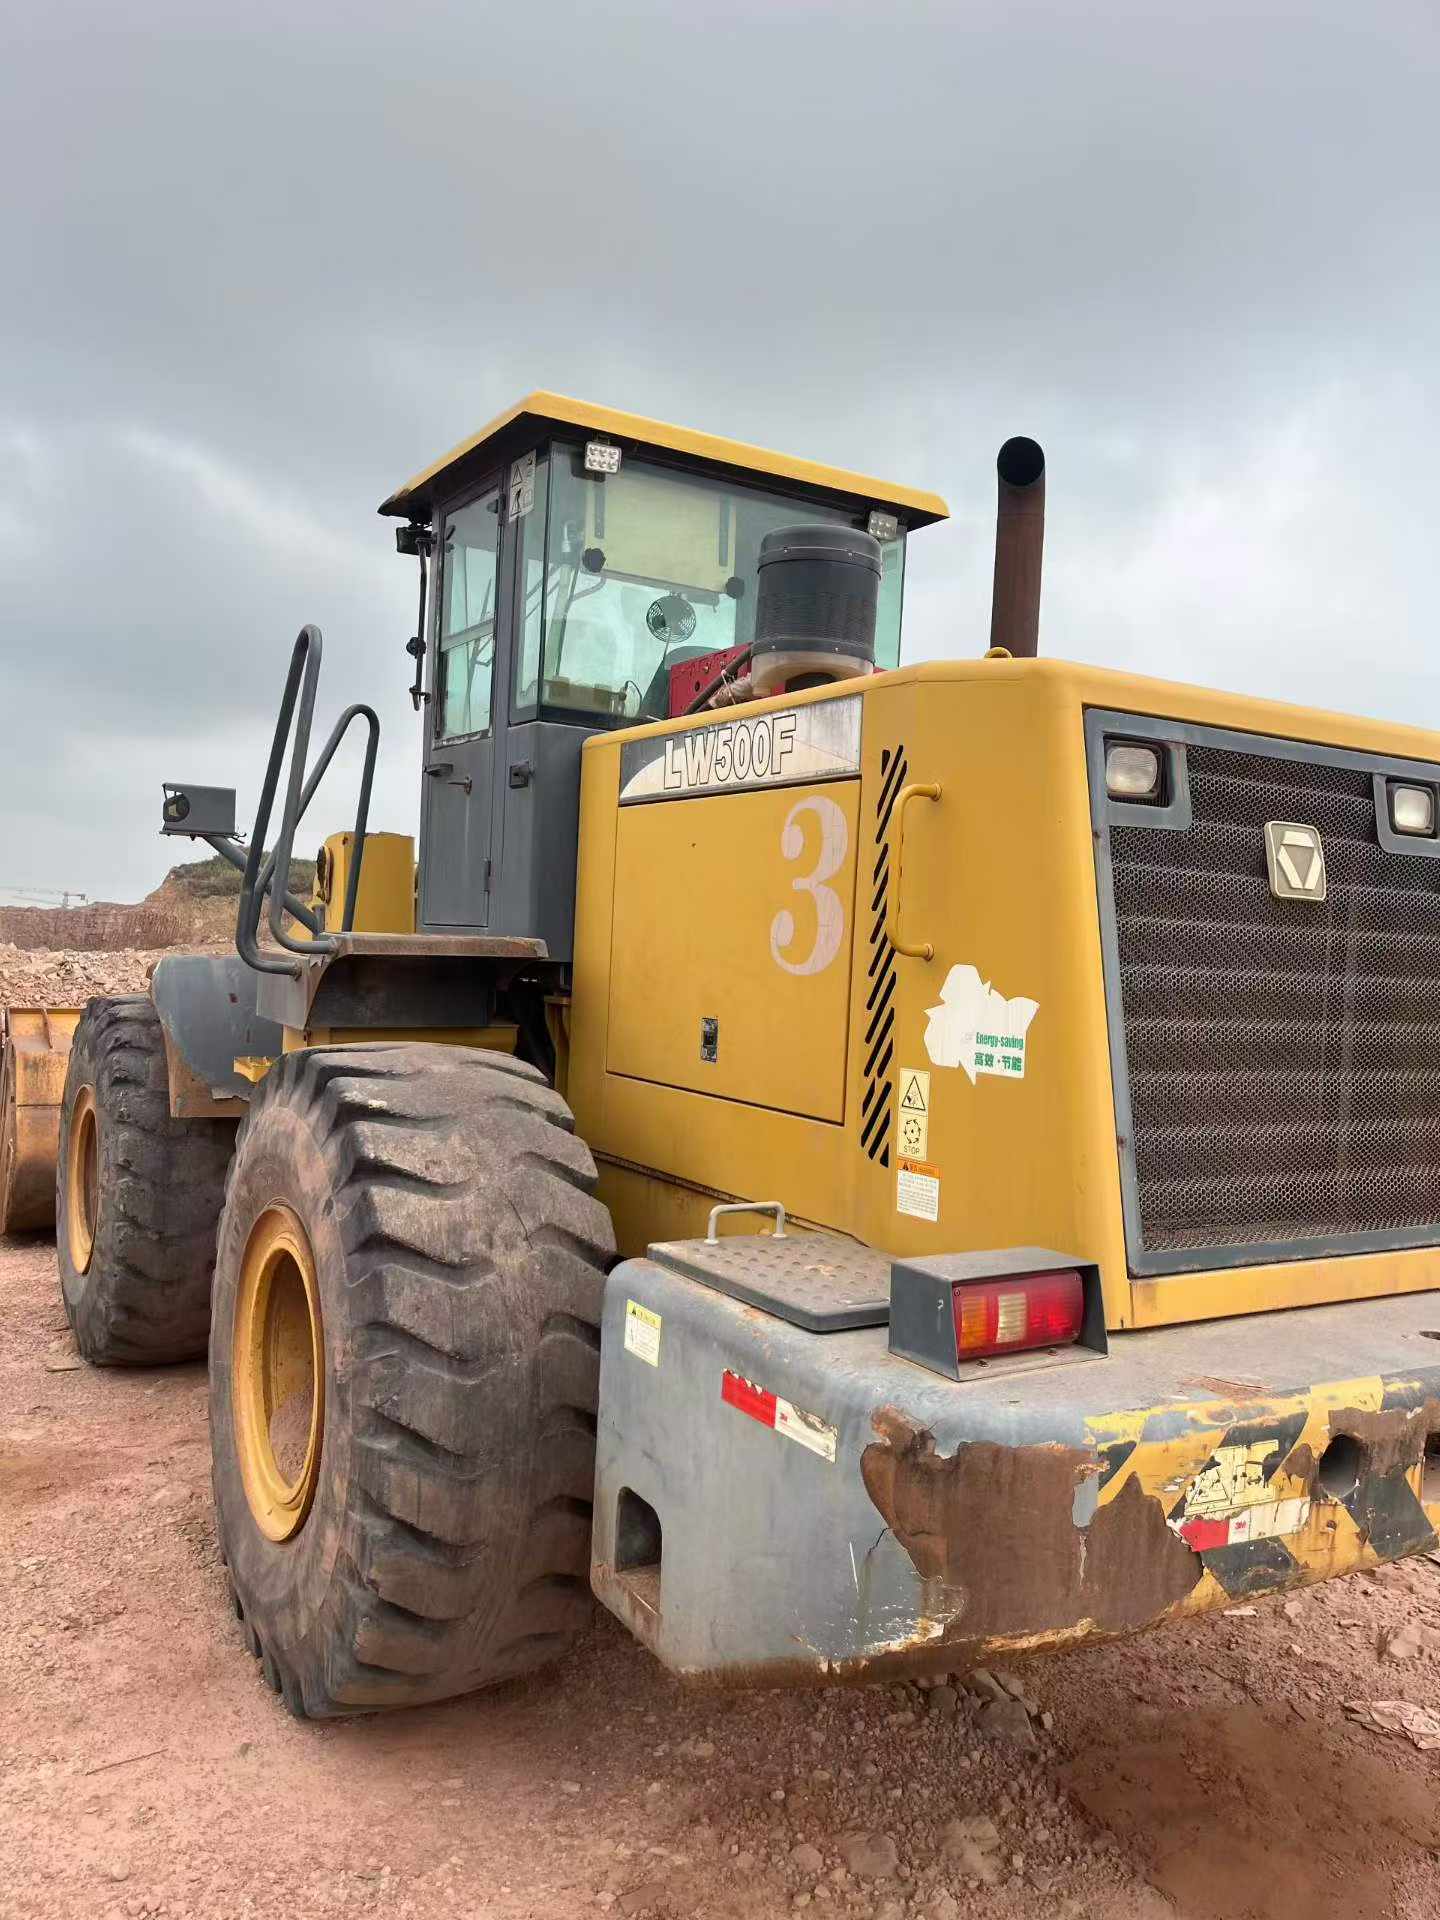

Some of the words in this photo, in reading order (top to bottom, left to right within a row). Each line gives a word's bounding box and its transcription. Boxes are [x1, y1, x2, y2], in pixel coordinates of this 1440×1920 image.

[663, 713, 797, 790] LW500F
[769, 795, 849, 977] 3
[976, 1032, 1024, 1050] Energy-saving
[903, 1145, 921, 1155] STOP
